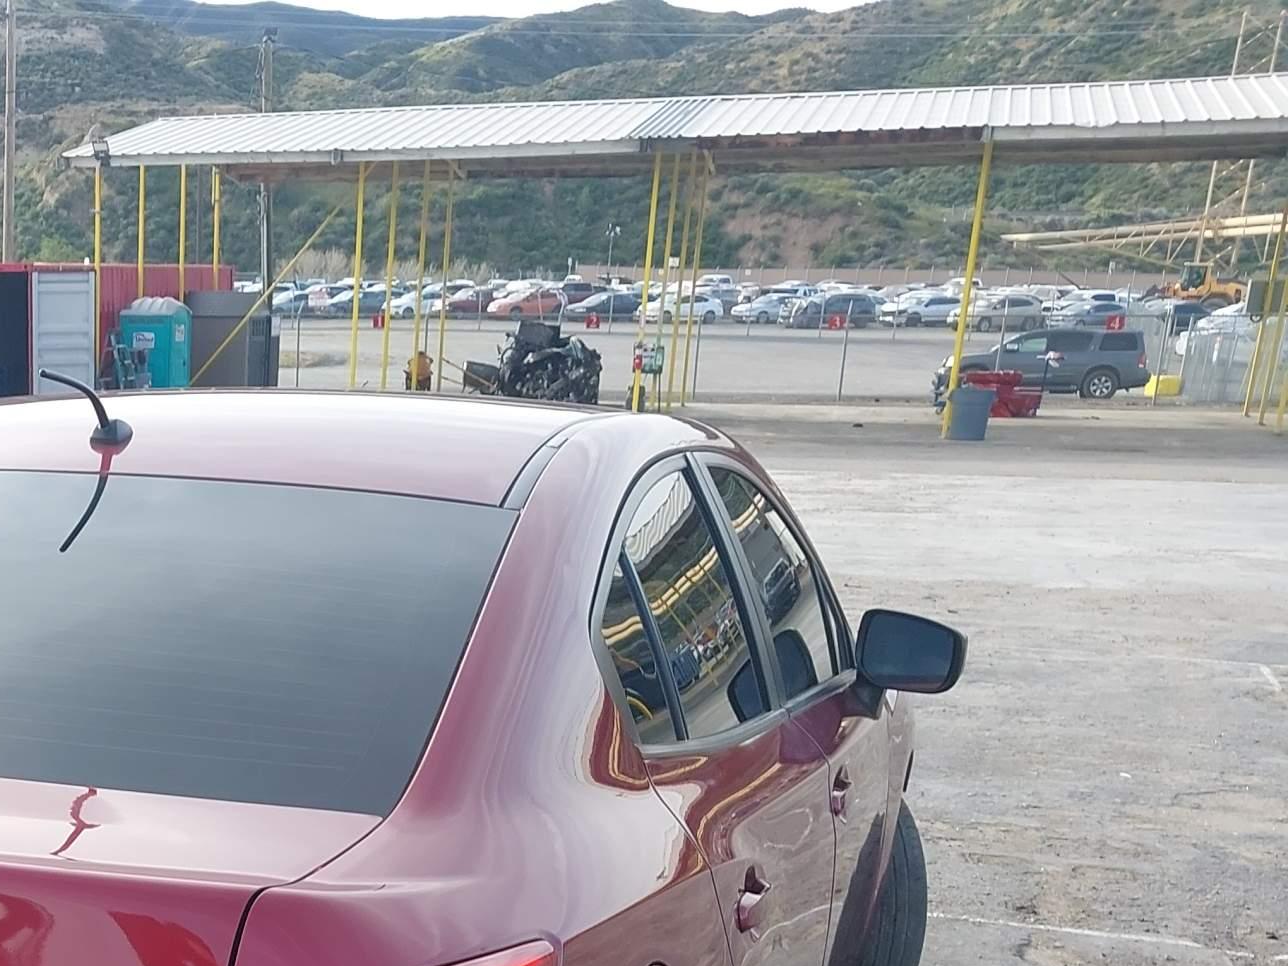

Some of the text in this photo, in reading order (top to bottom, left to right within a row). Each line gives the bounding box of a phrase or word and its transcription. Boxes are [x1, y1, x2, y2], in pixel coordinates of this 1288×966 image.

[589, 316, 597, 328] 2
[831, 315, 841, 329] 3
[1110, 315, 1120, 329] 4
